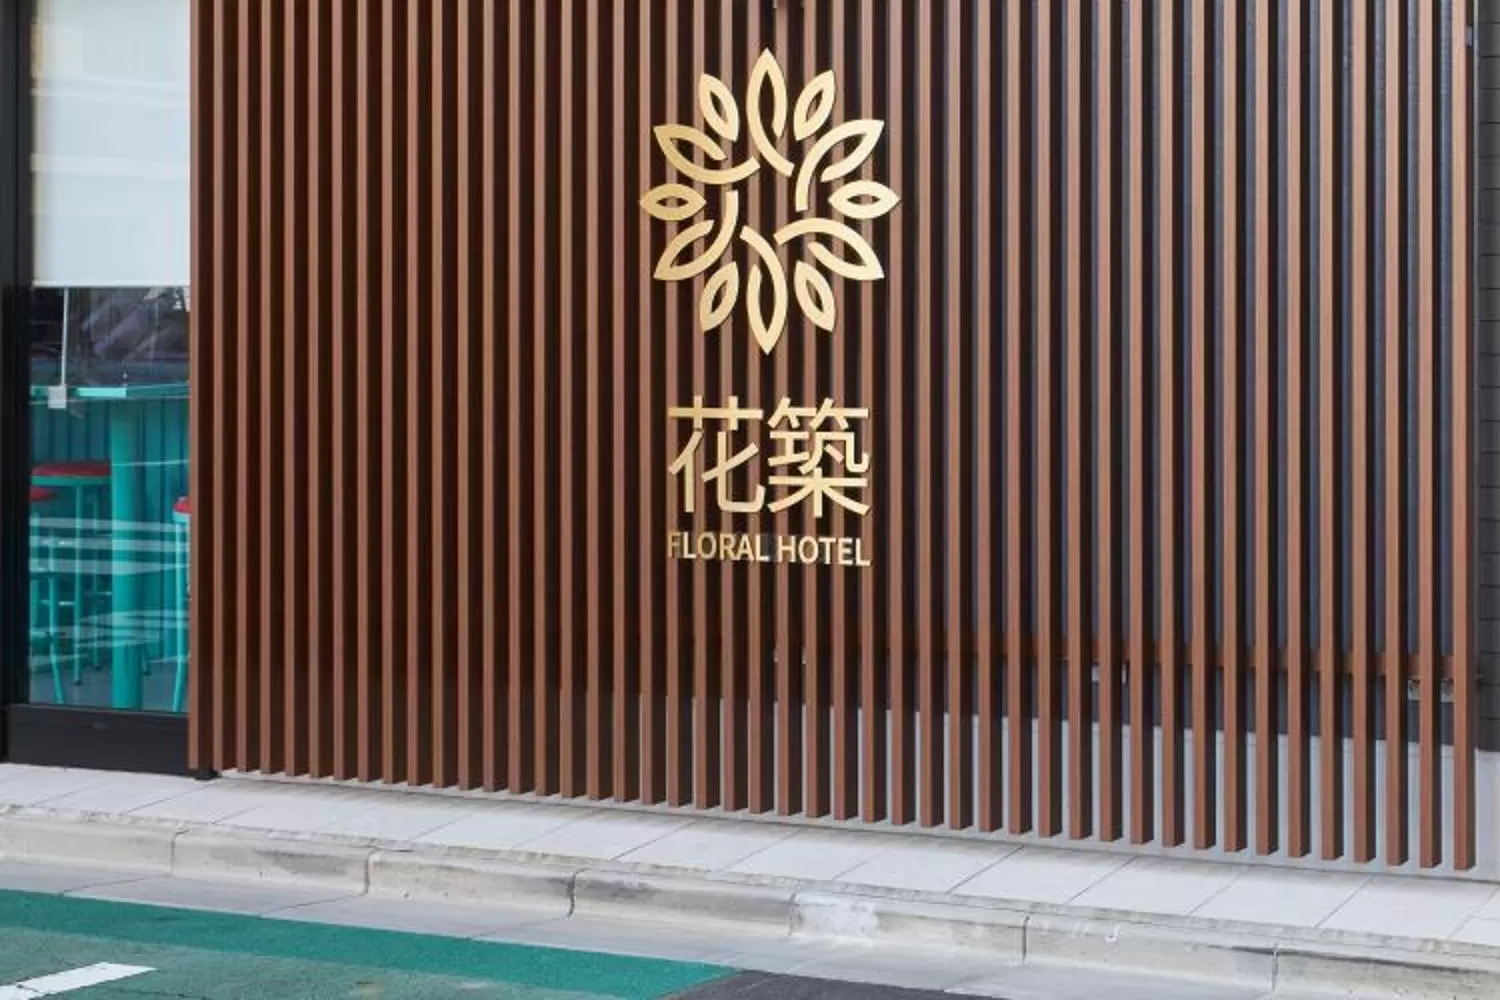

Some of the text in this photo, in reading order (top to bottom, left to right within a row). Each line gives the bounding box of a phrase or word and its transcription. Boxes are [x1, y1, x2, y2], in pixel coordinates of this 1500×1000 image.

[667, 395, 872, 518] 花築
[667, 531, 872, 567] FLORAL HOTEL
